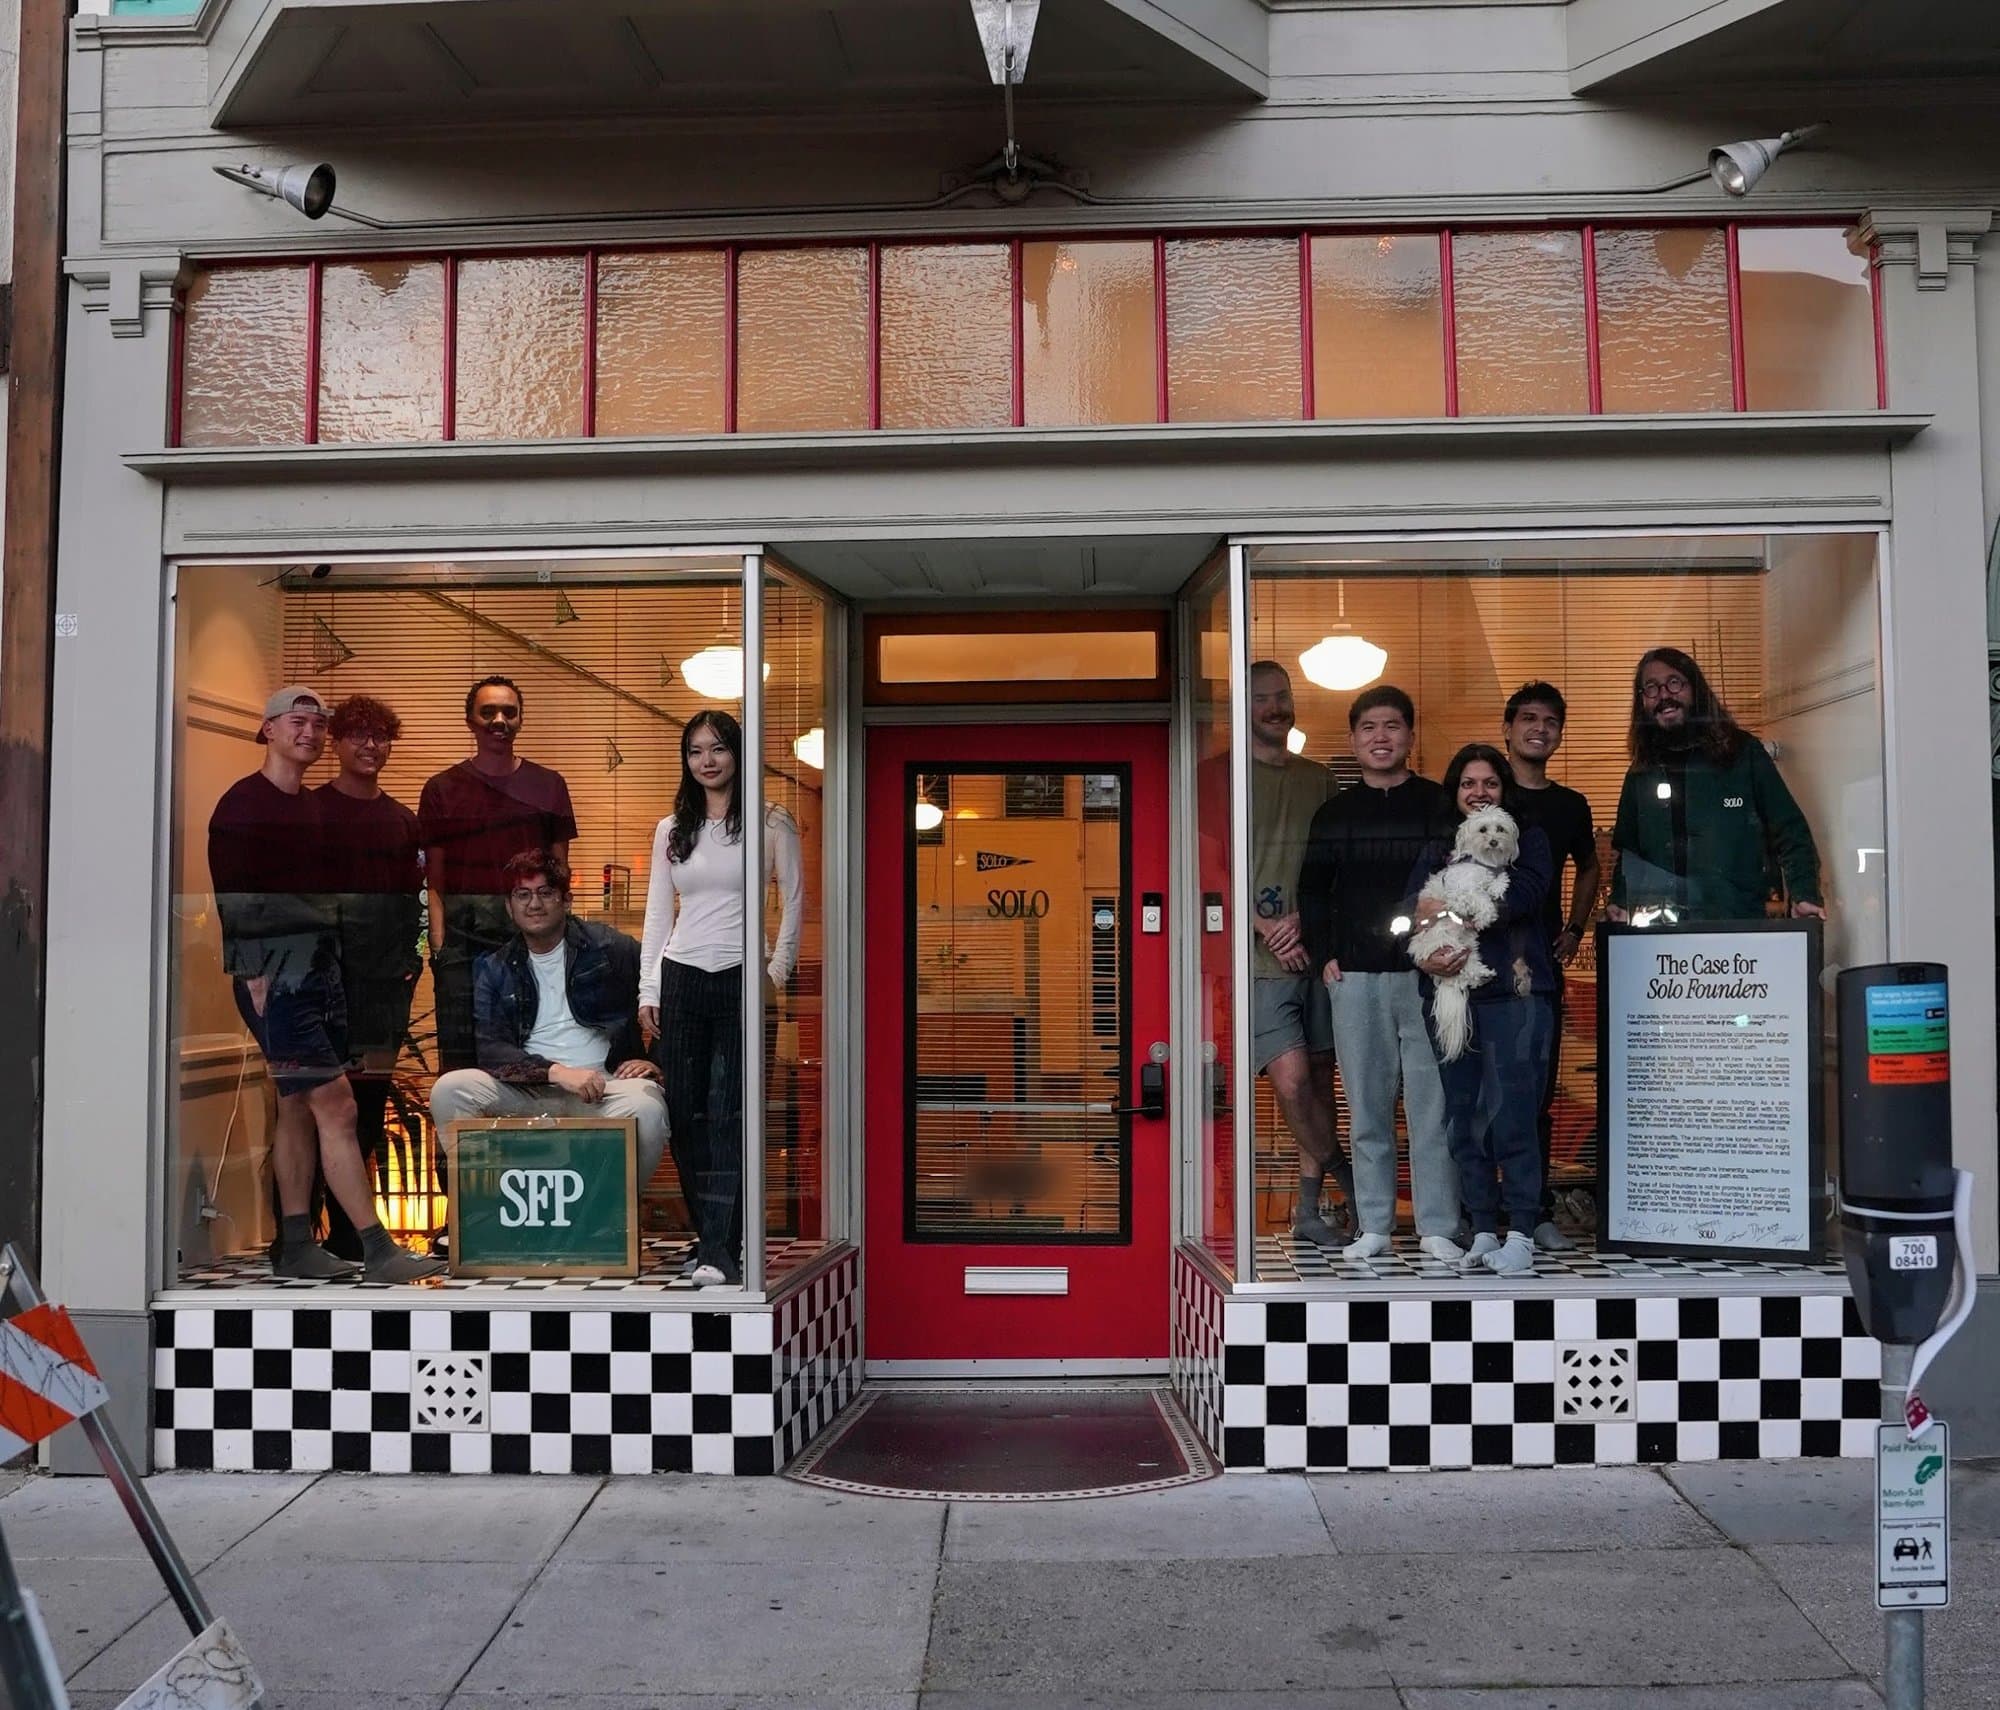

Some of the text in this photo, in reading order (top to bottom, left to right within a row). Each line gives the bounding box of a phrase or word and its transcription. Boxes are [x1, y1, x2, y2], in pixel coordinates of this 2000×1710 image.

[1723, 798, 1743, 807] SOLO
[980, 856, 1007, 870] SOLO
[987, 890, 1050, 918] SOLO
[1656, 953, 1758, 975] The Case for
[1647, 978, 1768, 999] Solo Founders
[499, 1169, 584, 1227] SFP
[1698, 1231, 1716, 1239] SOLO
[1902, 1244, 1925, 1254] 700
[1896, 1256, 1933, 1266] 08410
[1883, 1443, 1936, 1453] Paid Parking
[1883, 1488, 1923, 1497] Mon-Sat
[1883, 1499, 1924, 1508] 9am-6pm
